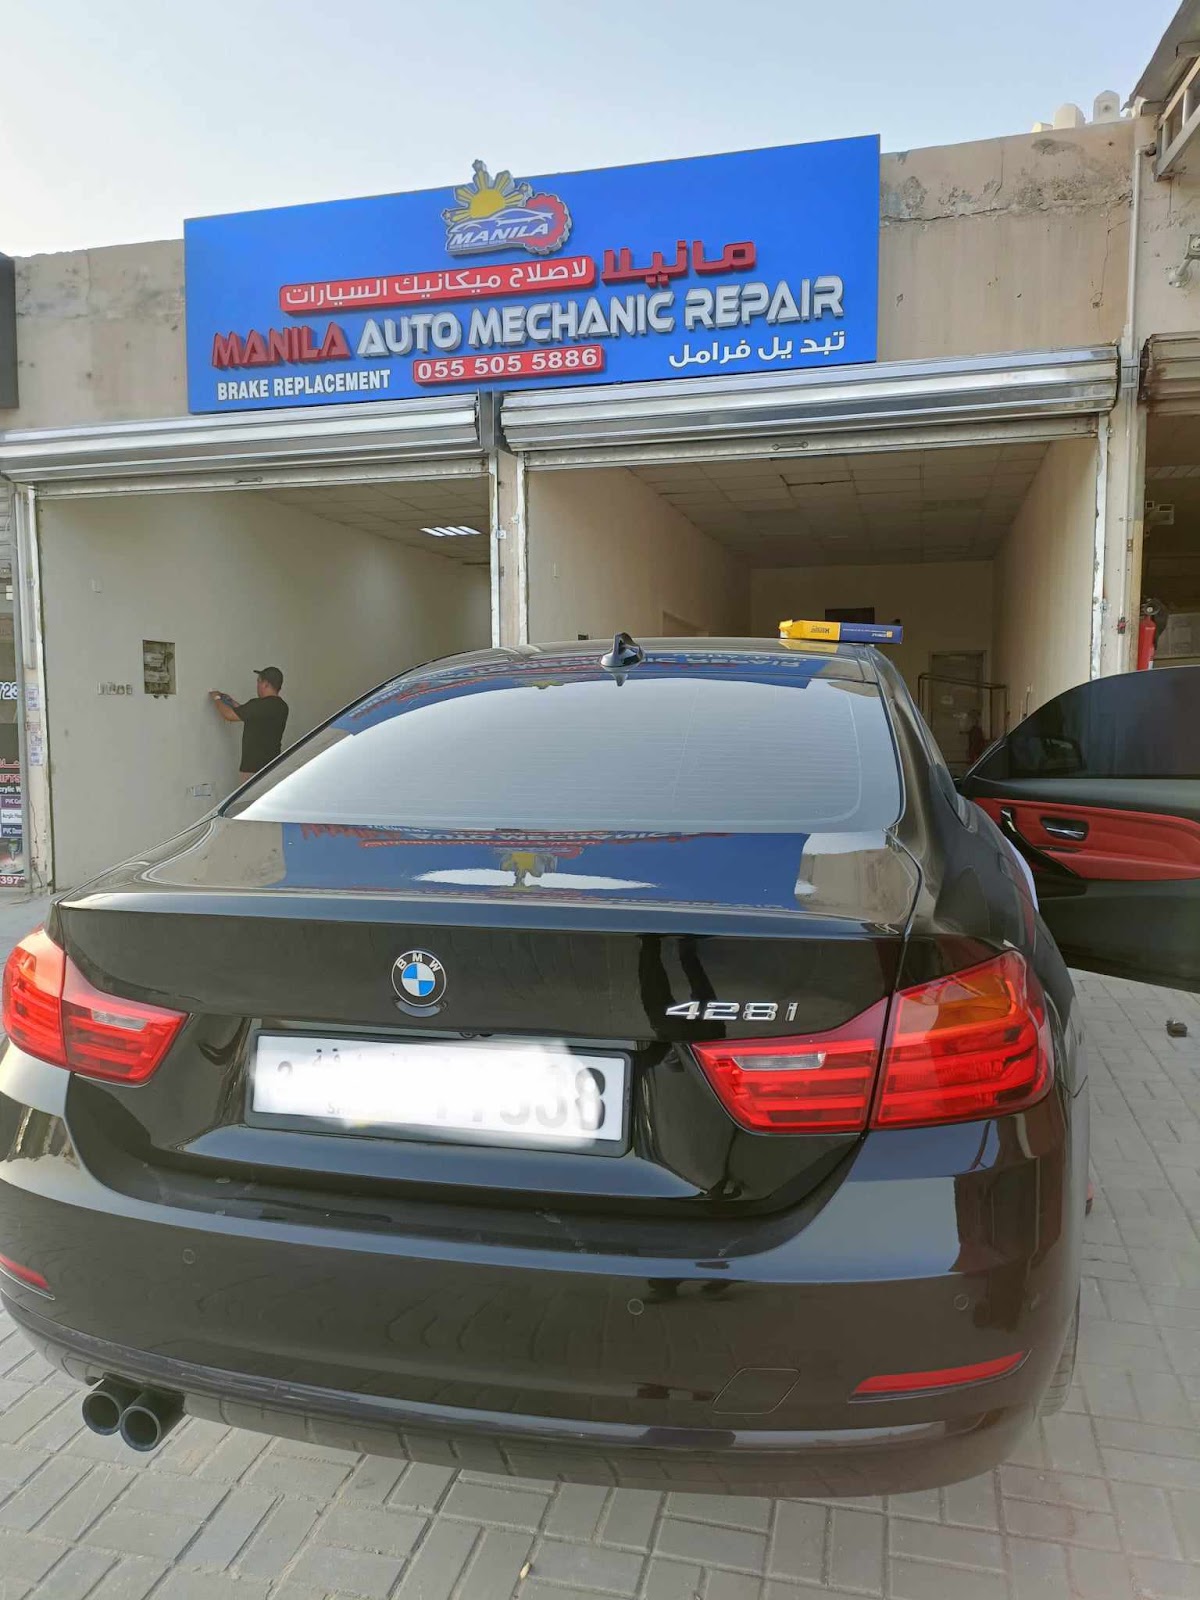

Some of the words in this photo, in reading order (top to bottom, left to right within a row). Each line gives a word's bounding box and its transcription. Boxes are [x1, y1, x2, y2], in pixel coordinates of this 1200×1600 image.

[450, 223, 549, 246] MANILA
[509, 258, 587, 288] لاصلاح
[601, 240, 757, 287] مانيلا
[285, 279, 388, 307] السيارات
[394, 271, 501, 298] ميكانيك
[211, 321, 351, 371] MANILA
[357, 311, 462, 358] AUTO
[468, 290, 675, 350] MECHANIC
[684, 275, 845, 331] REPAIR
[418, 359, 465, 380] 055
[474, 354, 522, 375] 505
[532, 348, 597, 370] 5886
[669, 339, 751, 369] فرامل
[217, 379, 270, 401] BRAKE
[274, 369, 391, 397] REPLACEMENT
[396, 952, 441, 972] BMW
[665, 1001, 799, 1022] 428i
